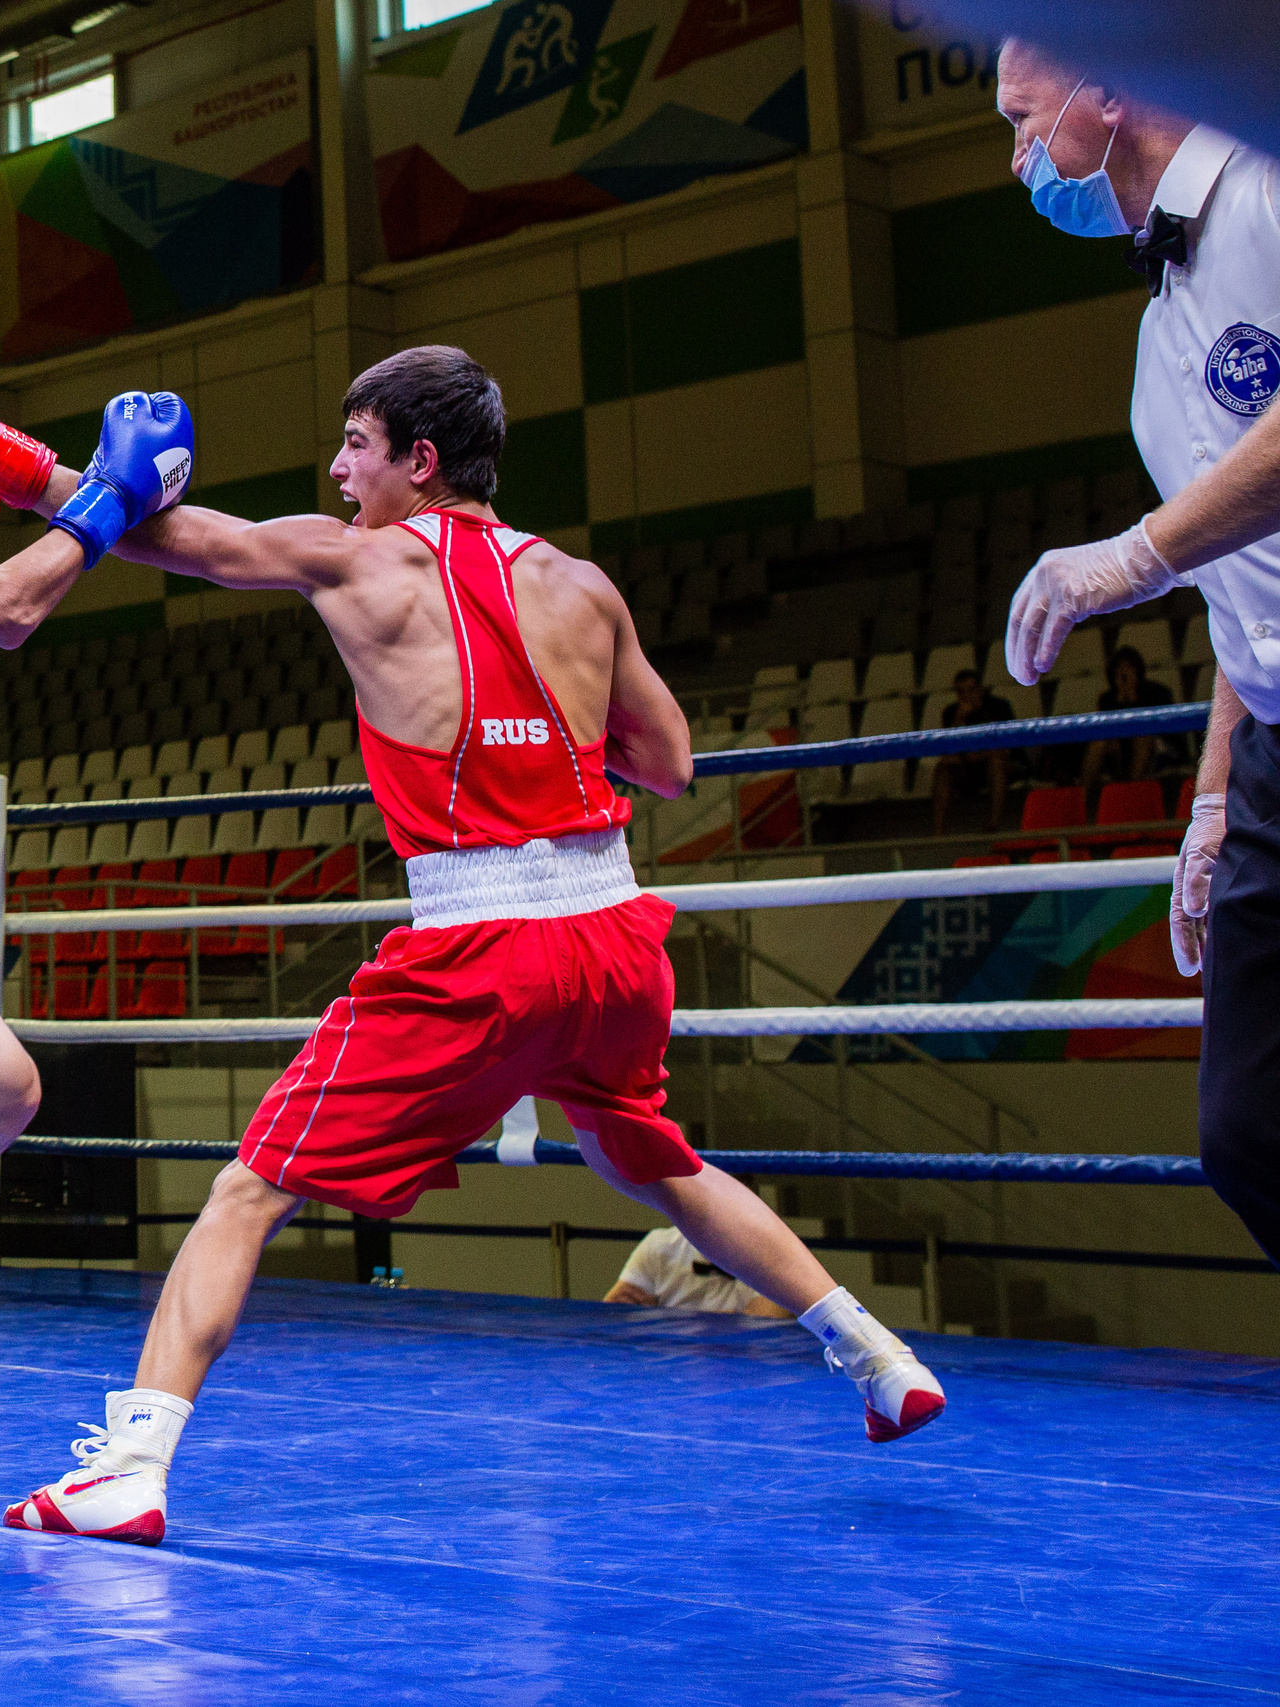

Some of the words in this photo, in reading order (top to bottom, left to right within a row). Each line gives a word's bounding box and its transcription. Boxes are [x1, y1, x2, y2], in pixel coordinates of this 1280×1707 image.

[1211, 329, 1273, 369] INTERNATIONAL
[1232, 356, 1268, 383] aiba
[1216, 387, 1251, 411] BOXING
[1251, 387, 1271, 400] R&J
[123, 403, 138, 421] Star
[163, 454, 190, 484] GREEN
[165, 469, 188, 494] HILL
[480, 718, 550, 746] RUS
